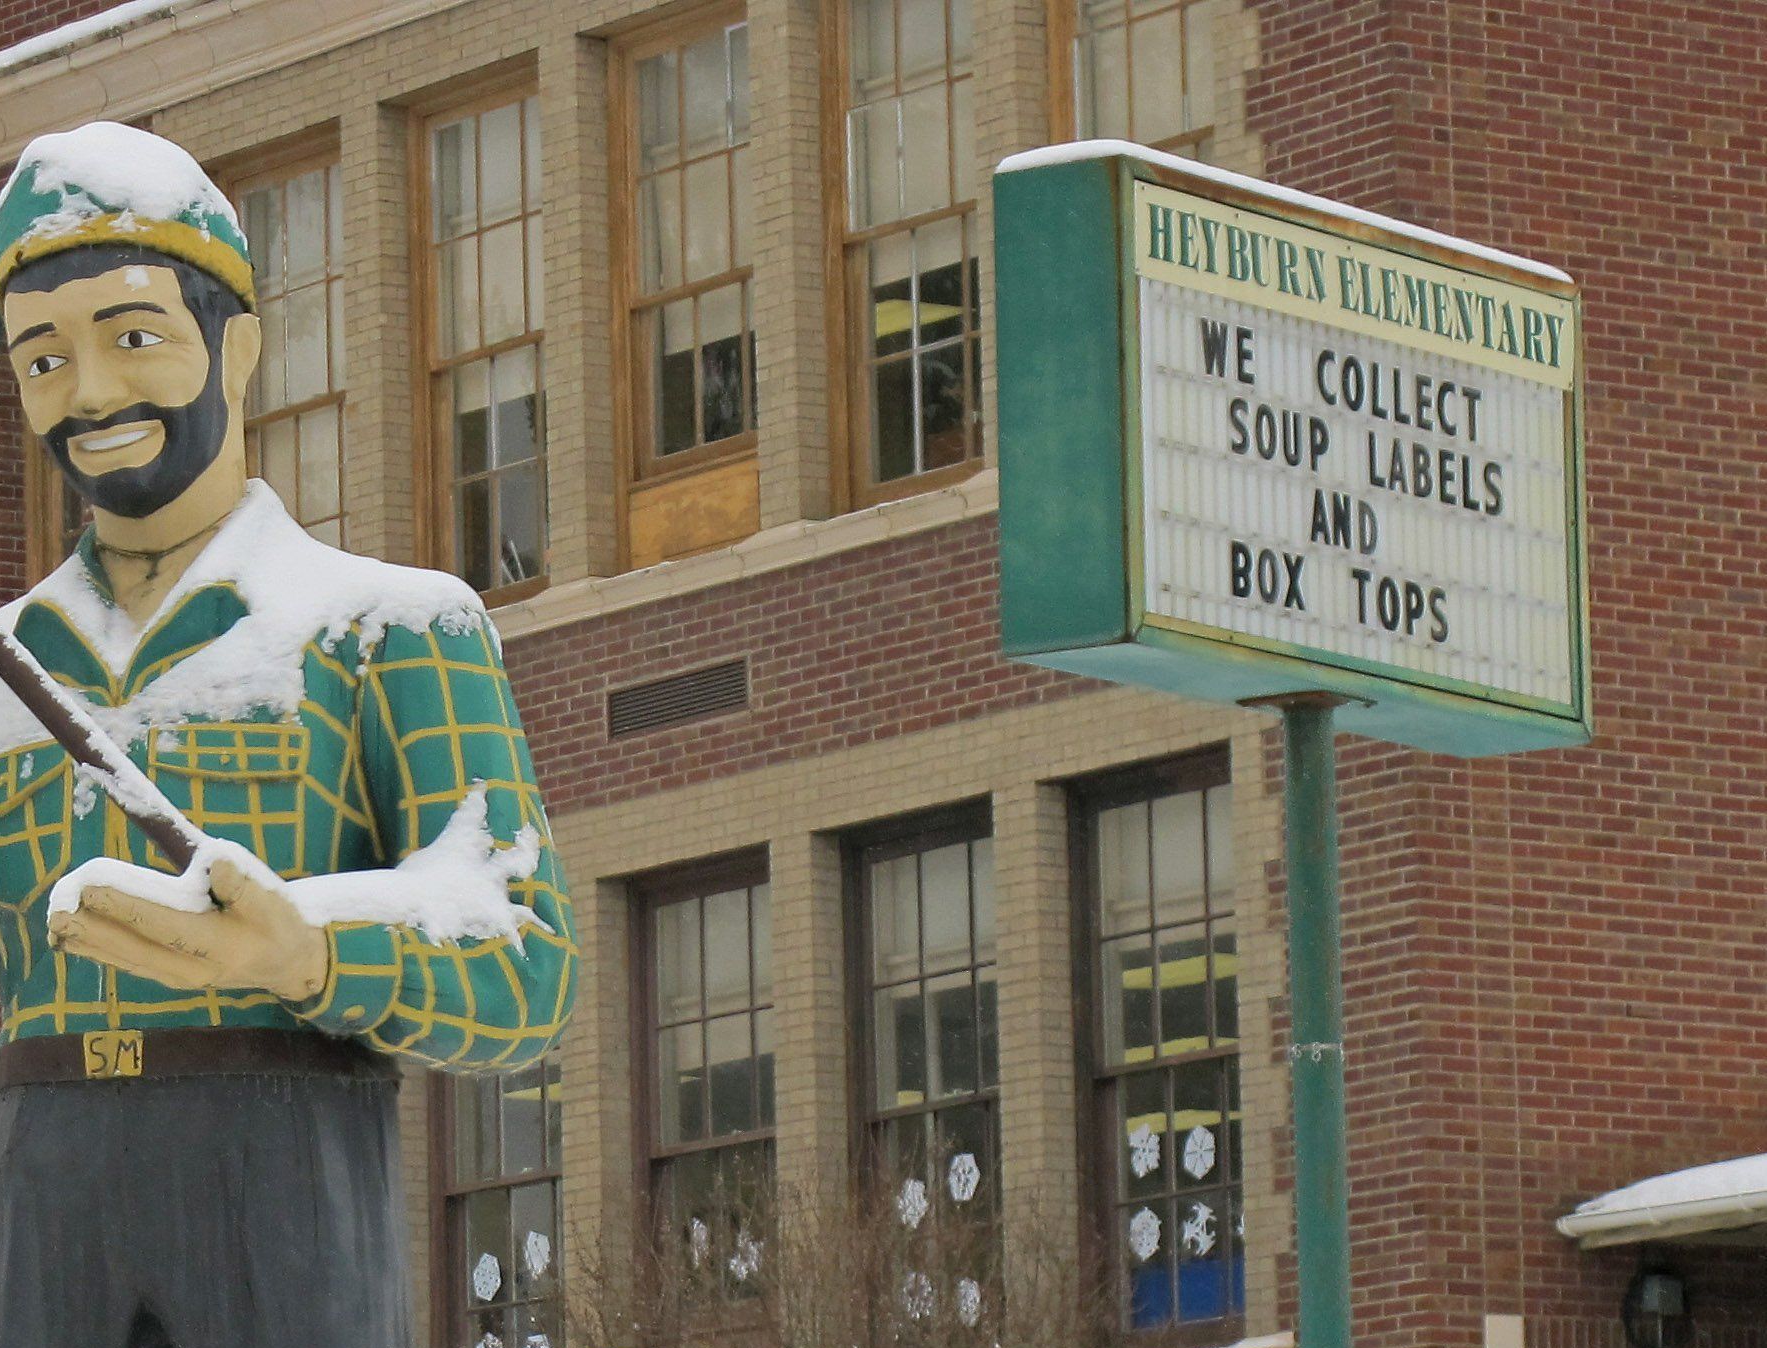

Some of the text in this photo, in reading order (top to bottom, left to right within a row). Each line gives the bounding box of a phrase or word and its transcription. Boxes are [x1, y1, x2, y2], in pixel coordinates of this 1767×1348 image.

[1148, 202, 1565, 369] HEYBURN ELEMENTARY
[1201, 317, 1483, 442] WE COLLECT
[1231, 397, 1504, 516] SOUP LABELS
[1311, 488, 1379, 555] AND
[1232, 540, 1450, 643] BOX TOPS
